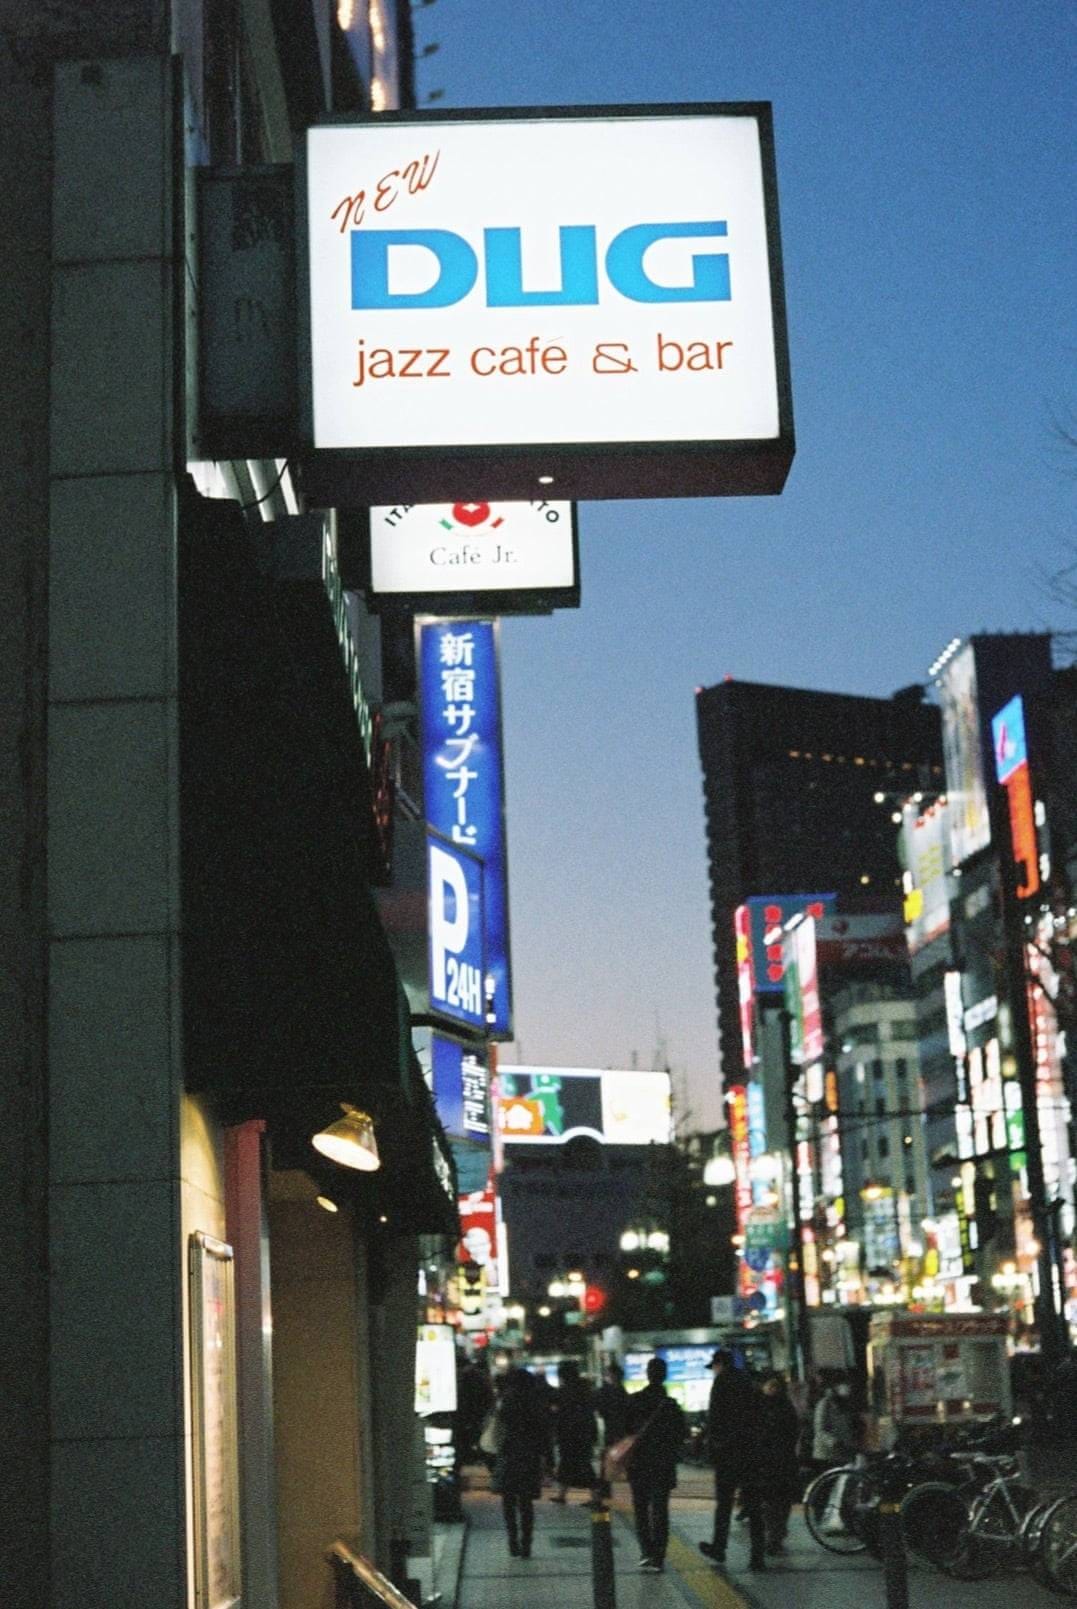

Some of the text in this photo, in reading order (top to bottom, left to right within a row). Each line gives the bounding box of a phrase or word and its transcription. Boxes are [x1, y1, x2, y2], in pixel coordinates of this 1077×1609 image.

[350, 220, 732, 311] DUG
[352, 339, 451, 387] jazz
[591, 342, 639, 374] &
[656, 332, 734, 373] bar
[429, 844, 470, 1002] P
[446, 957, 483, 1017] 24H
